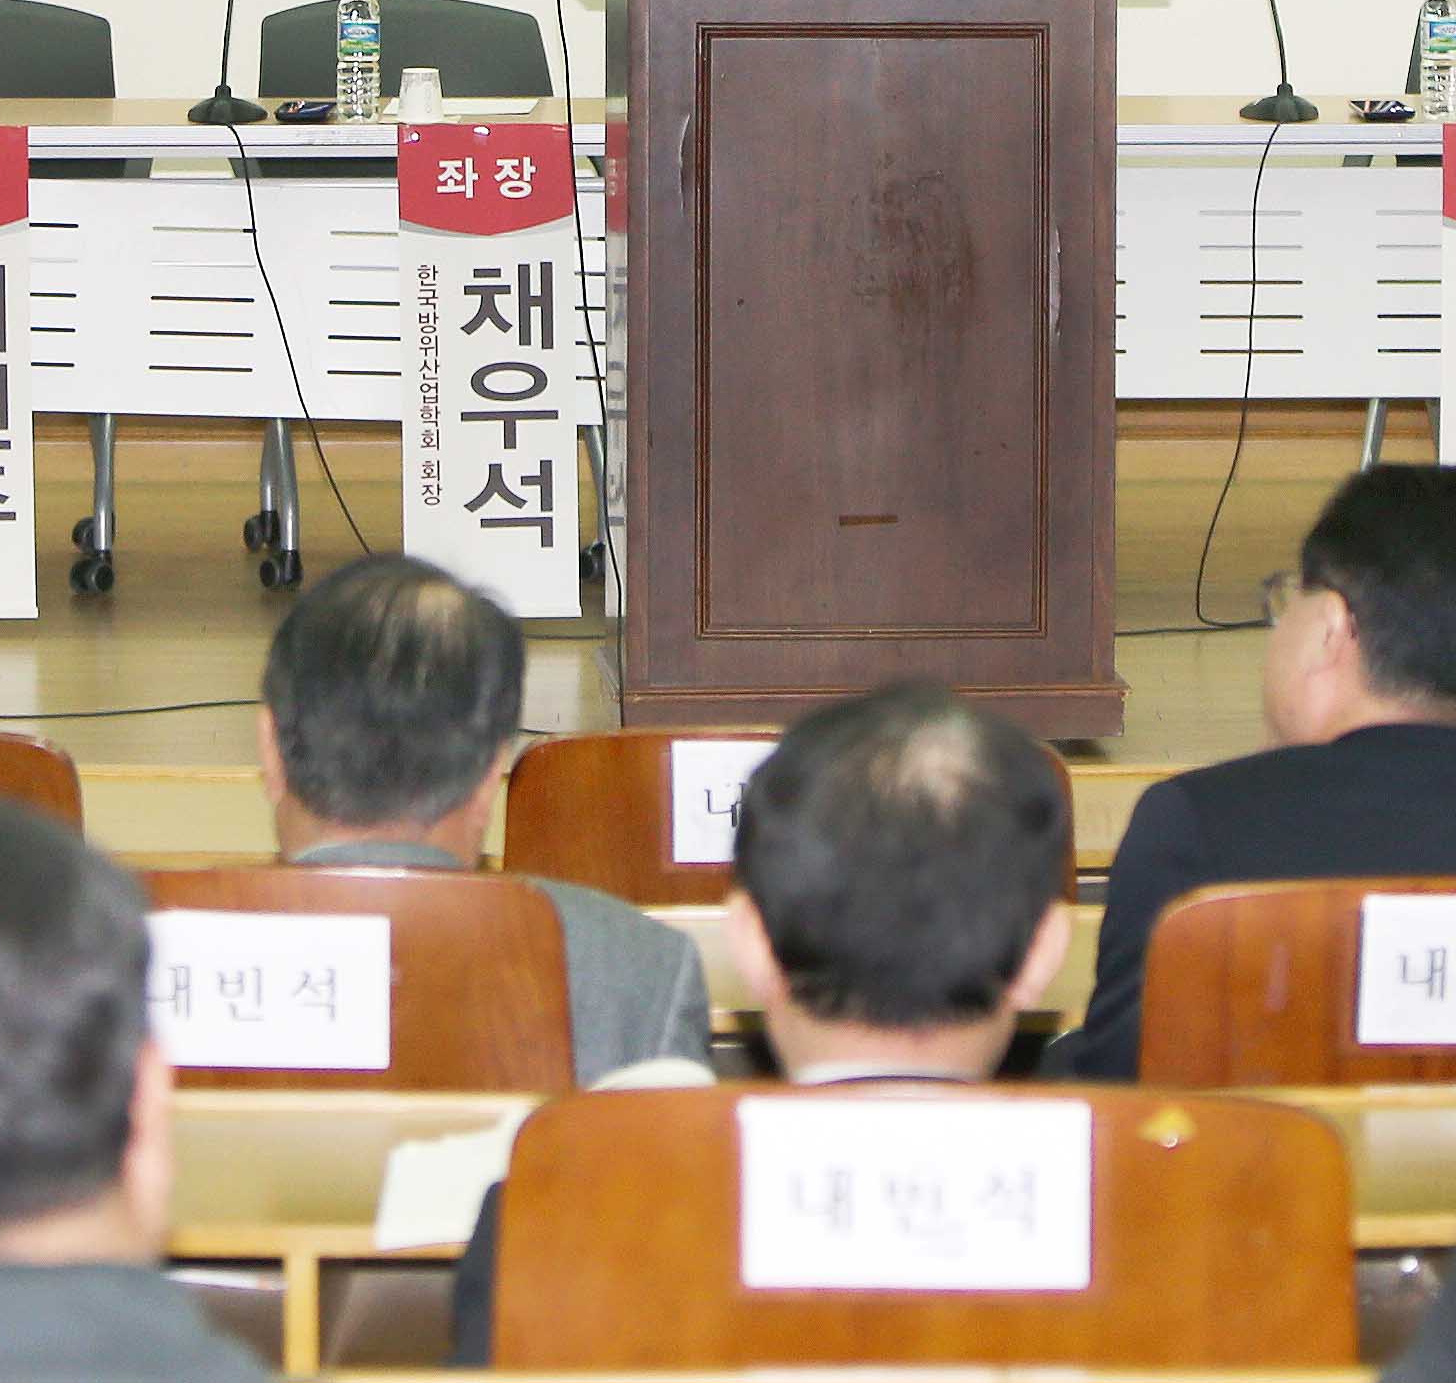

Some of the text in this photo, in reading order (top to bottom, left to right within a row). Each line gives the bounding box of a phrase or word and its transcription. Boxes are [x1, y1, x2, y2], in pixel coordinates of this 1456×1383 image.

[416, 264, 443, 506] 한국방위산업학회 회장
[459, 261, 559, 548] 채우석
